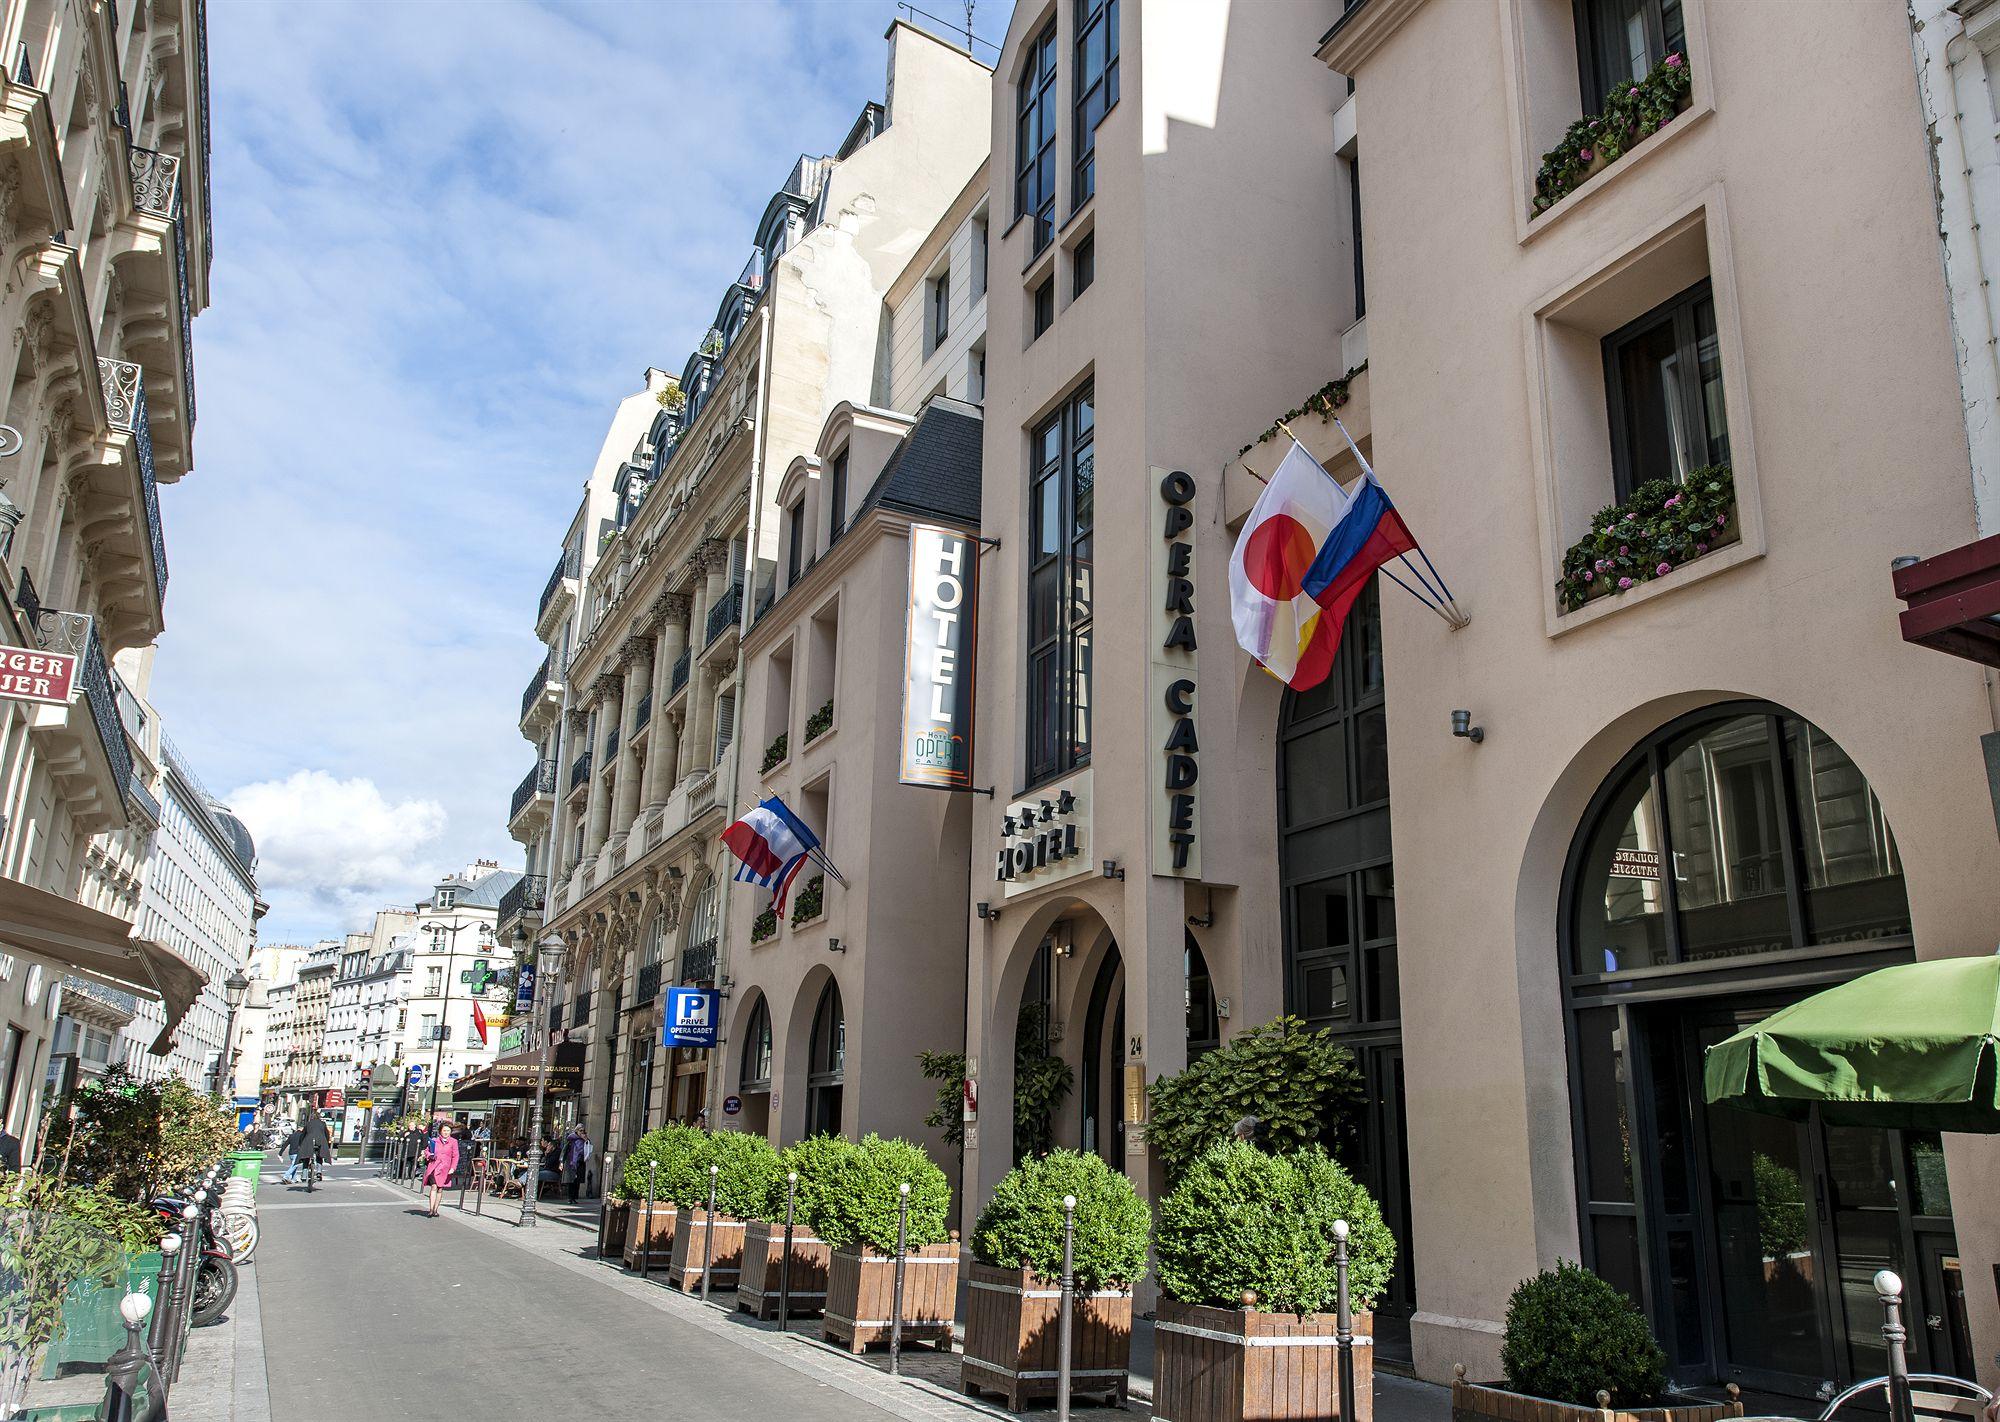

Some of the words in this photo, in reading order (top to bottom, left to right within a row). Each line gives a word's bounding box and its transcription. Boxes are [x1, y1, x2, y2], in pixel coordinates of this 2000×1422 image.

[1161, 471, 1198, 651] OPERA
[930, 538, 963, 723] HOTEL
[1164, 679, 1199, 868] CADET
[995, 824, 1079, 881] HOTEL
[684, 996, 705, 1018] P
[670, 1026, 692, 1034] OPERA
[692, 1027, 713, 1035] CADET
[1130, 1036, 1142, 1056] 24
[496, 1064, 528, 1072] BISTROT
[502, 1076, 520, 1085] LE
[526, 1077, 570, 1087] CDET
